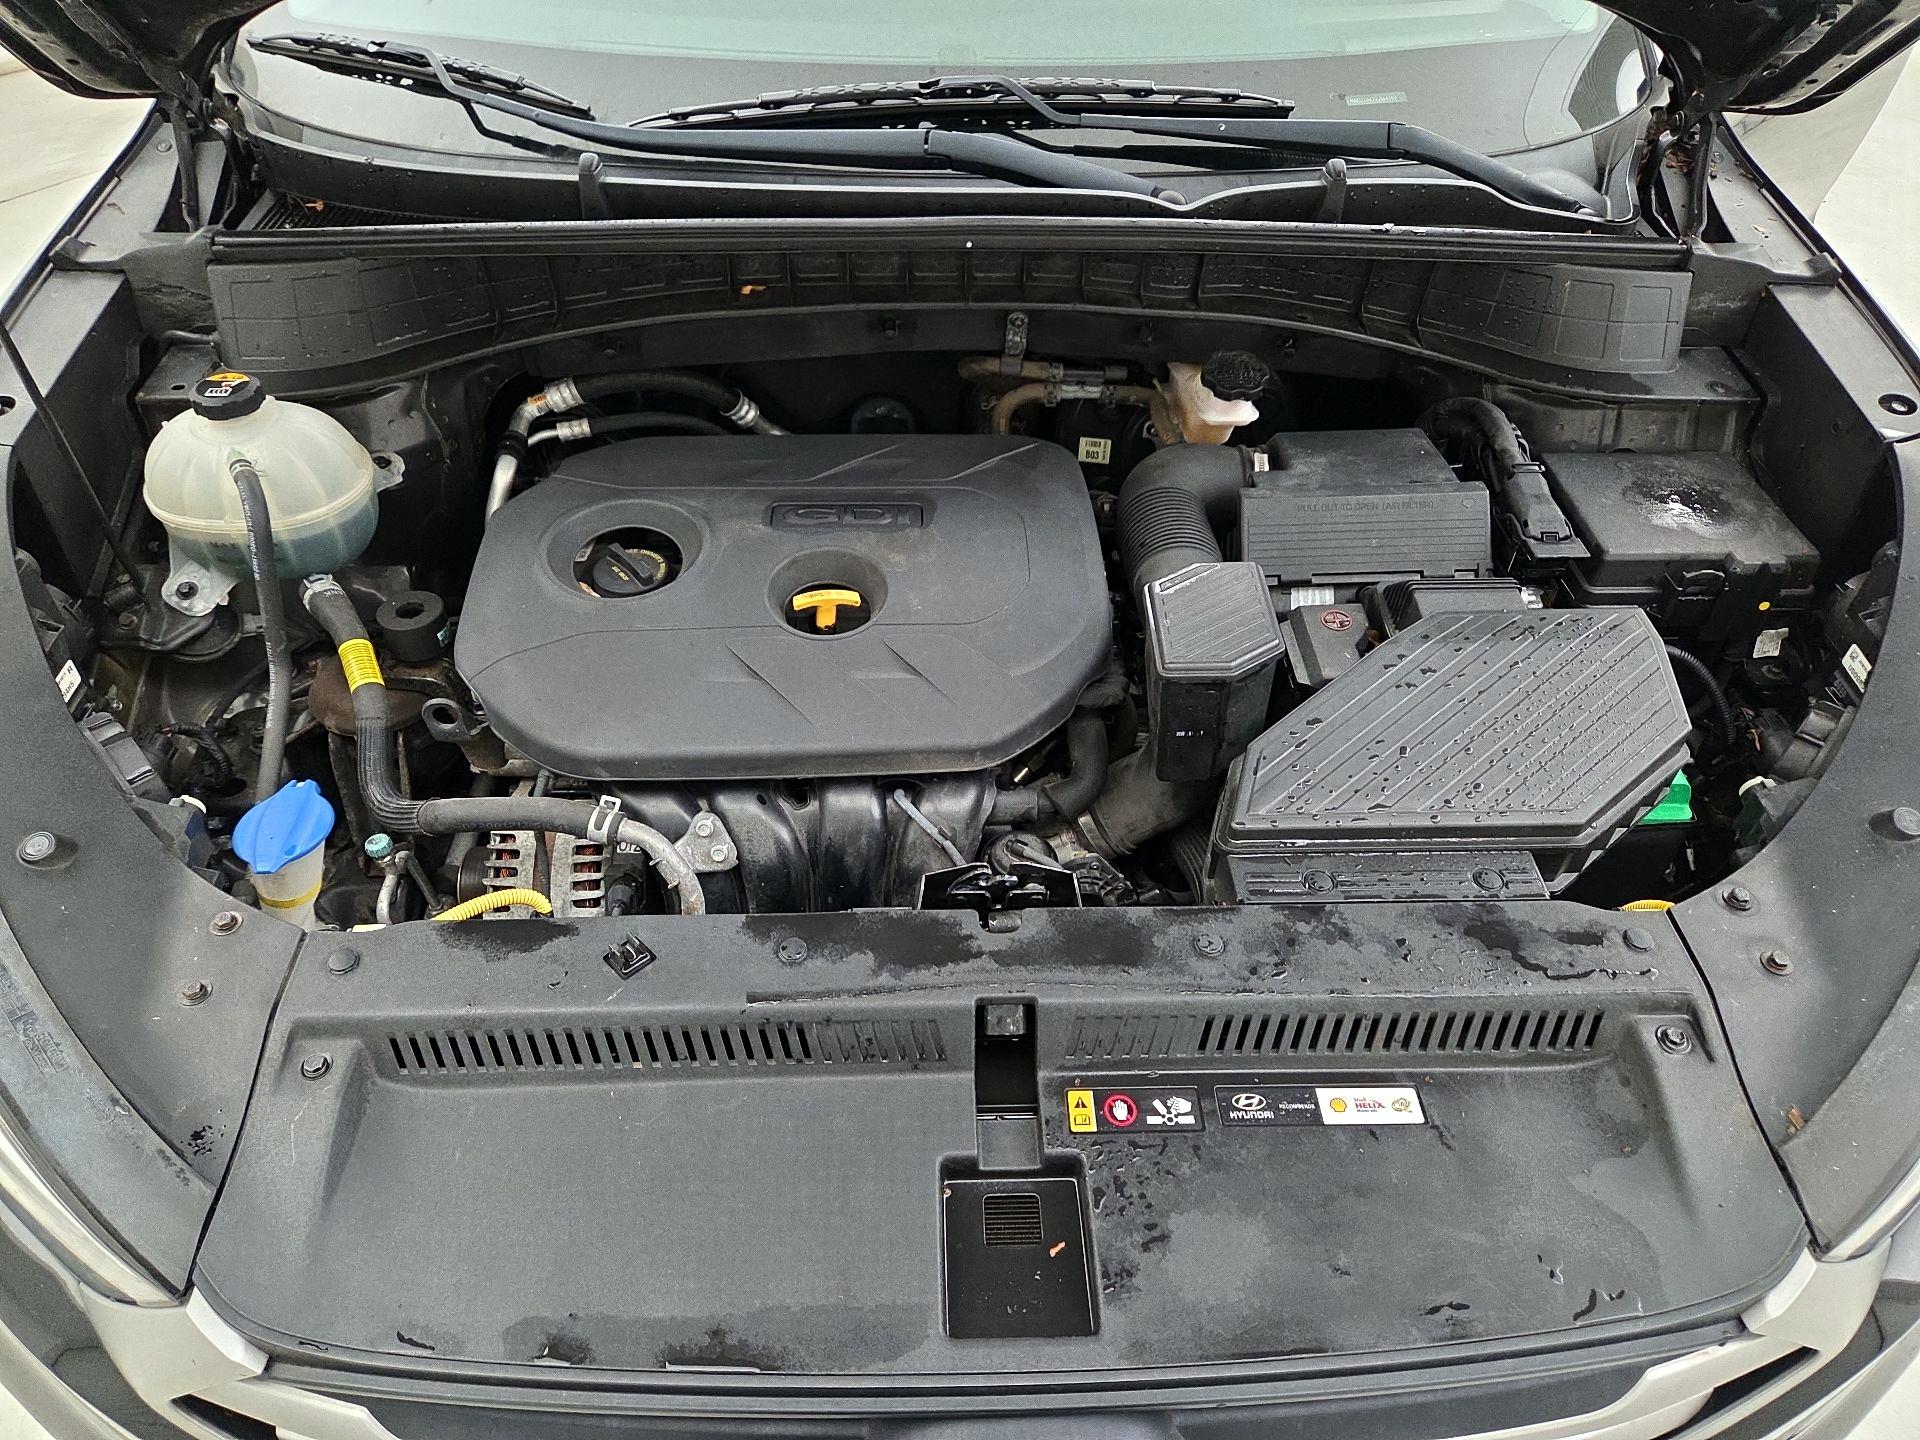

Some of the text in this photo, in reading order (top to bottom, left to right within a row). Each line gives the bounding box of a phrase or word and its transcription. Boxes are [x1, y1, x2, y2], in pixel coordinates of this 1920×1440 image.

[1321, 502, 1338, 512] OUT
[1354, 501, 1378, 510] OPEN
[1402, 499, 1434, 510] FILTER)
[784, 506, 910, 525] GDI
[1229, 1110, 1275, 1119] HYUNDAI
